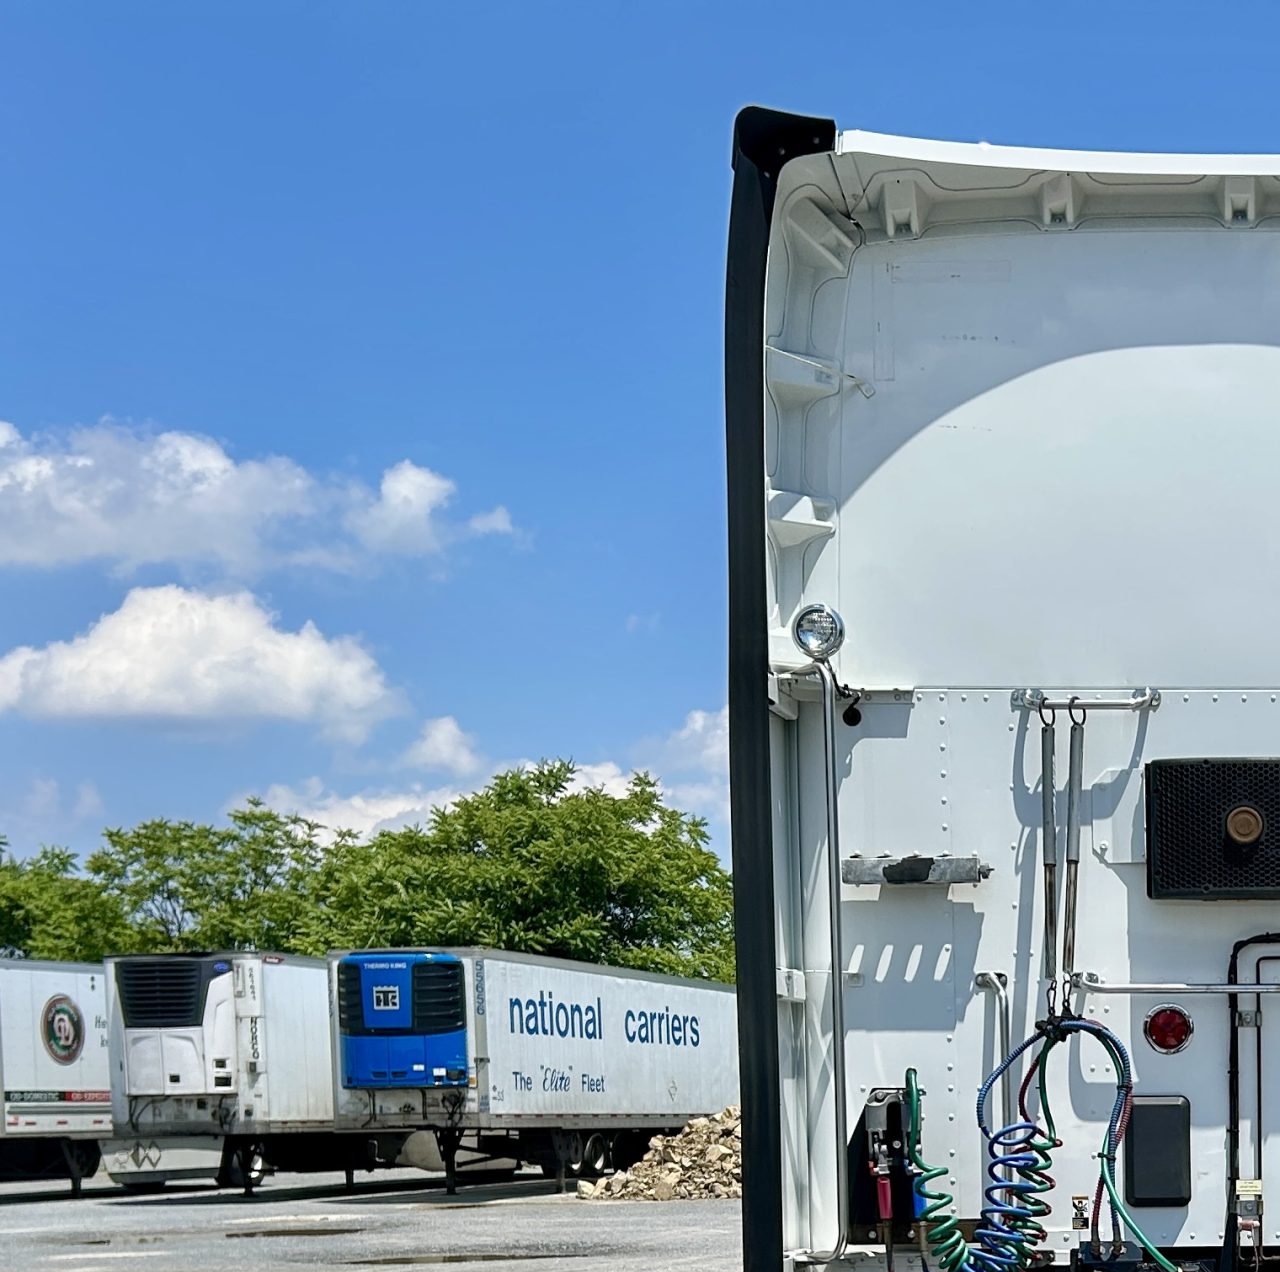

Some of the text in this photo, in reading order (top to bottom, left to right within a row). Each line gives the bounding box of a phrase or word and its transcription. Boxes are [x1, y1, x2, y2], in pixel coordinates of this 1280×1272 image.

[363, 961, 407, 970] THERMO KING
[509, 991, 701, 1048] national carriers
[512, 1071, 533, 1092] The
[581, 1074, 605, 1093] Fleet
